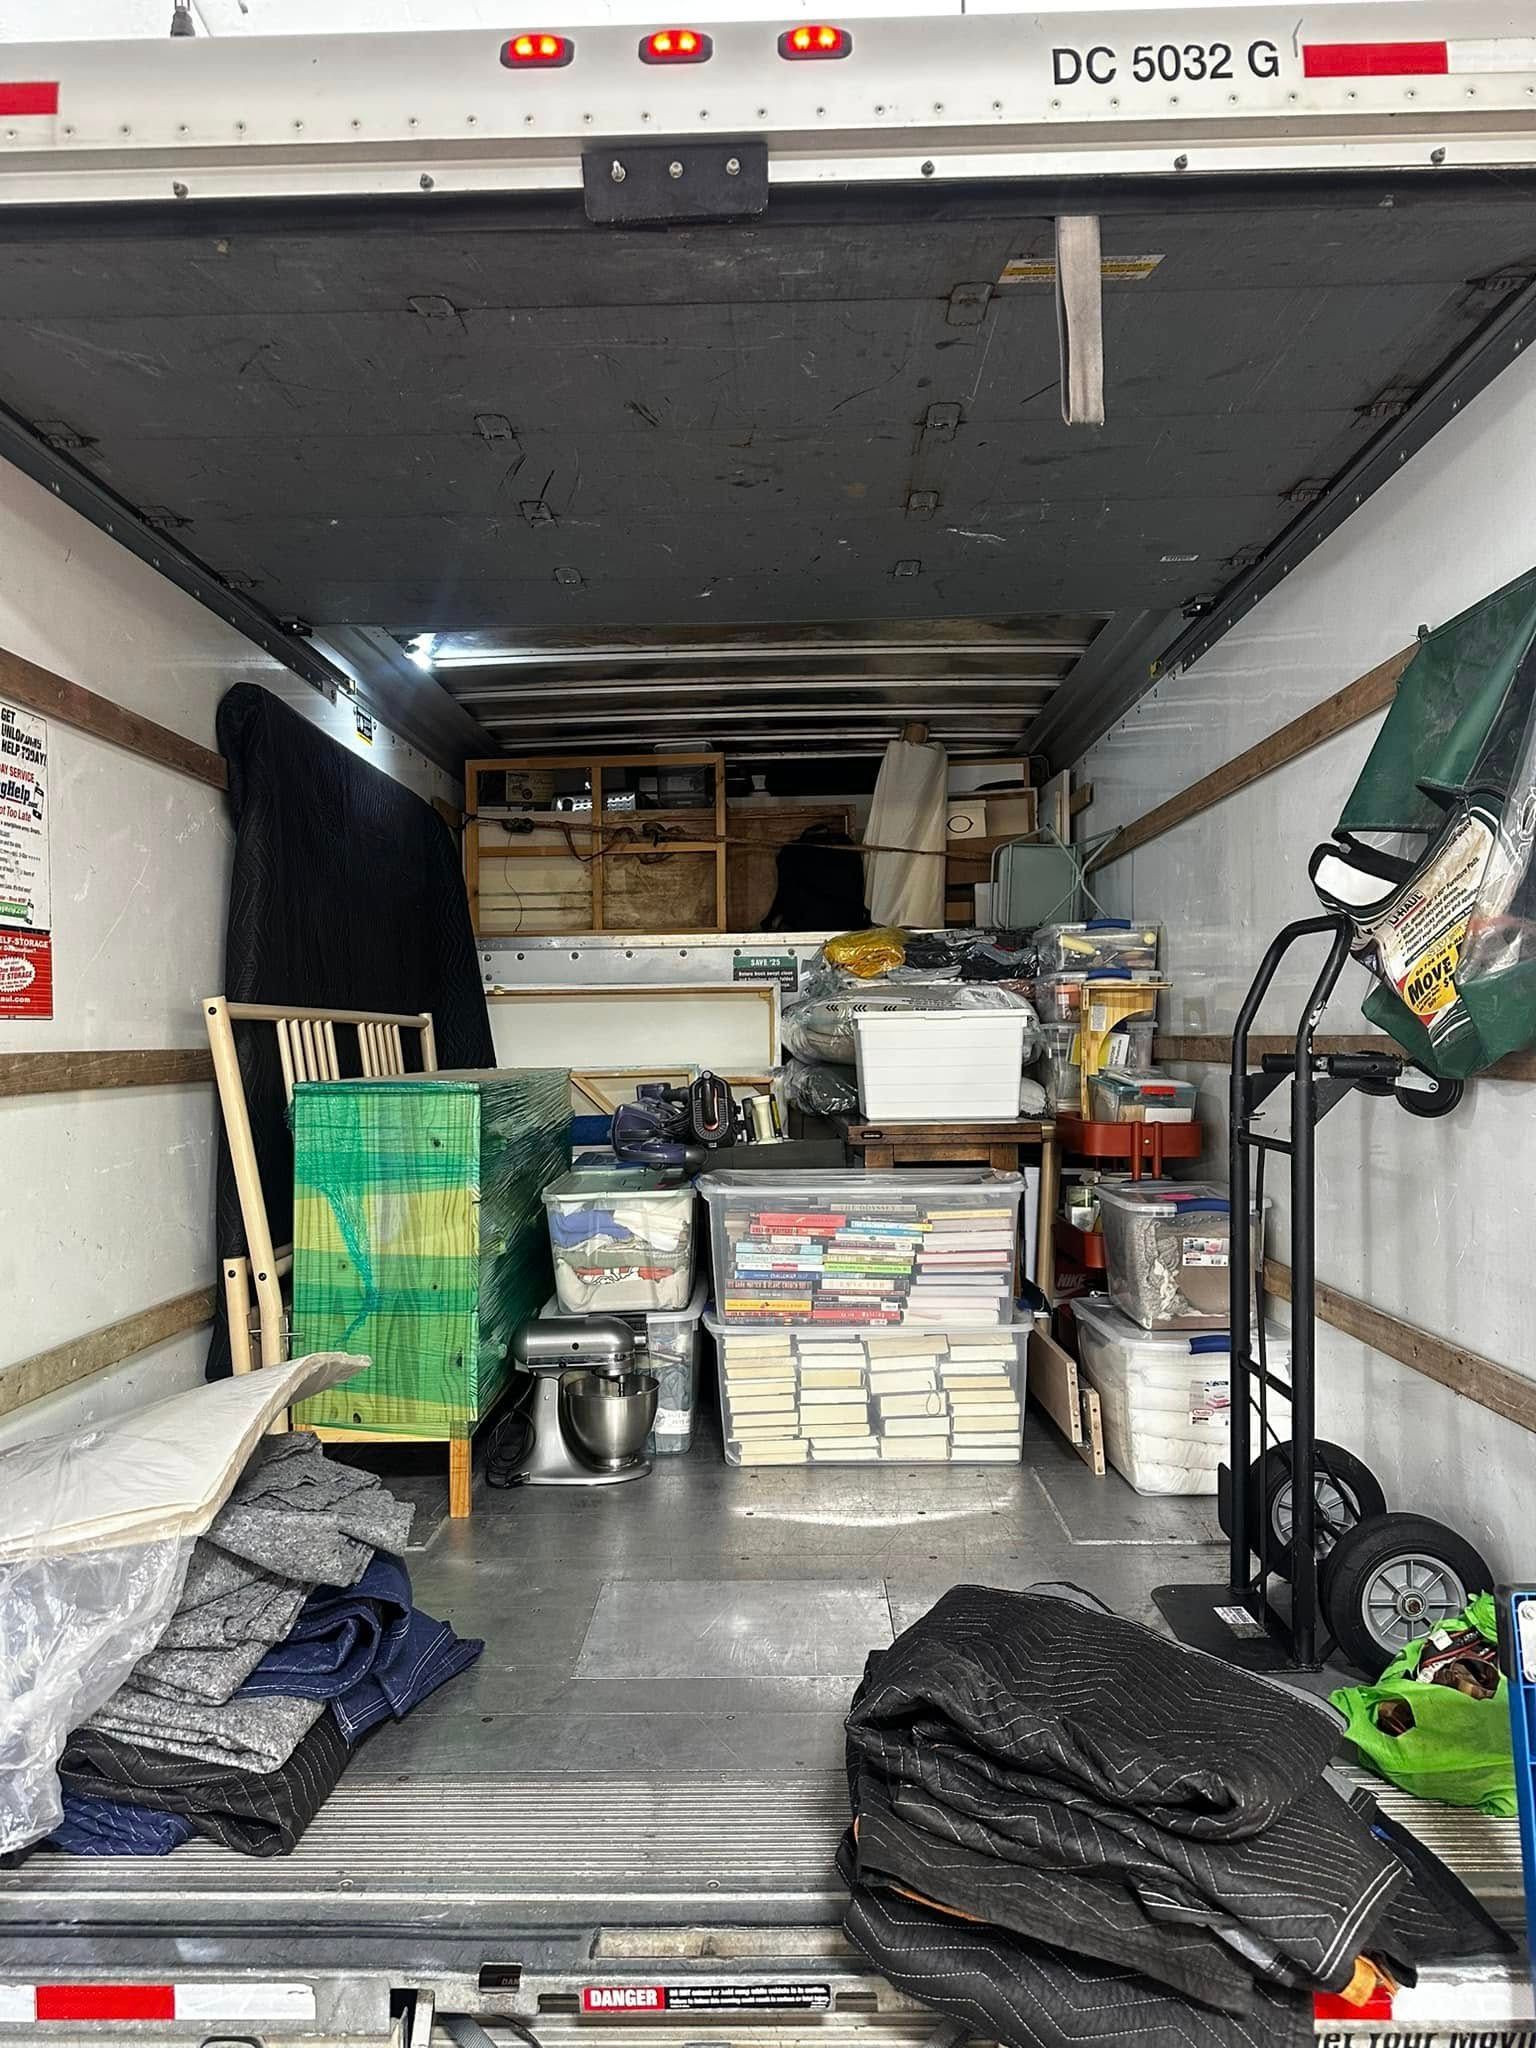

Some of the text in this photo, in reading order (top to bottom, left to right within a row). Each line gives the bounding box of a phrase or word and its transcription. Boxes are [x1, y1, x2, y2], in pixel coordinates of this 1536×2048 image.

[1052, 40, 1279, 85] DC 5032 G
[1, 707, 16, 724] GET
[1, 740, 47, 767] HELP TODAY!
[9, 766, 35, 784] SERVICE
[6, 805, 18, 818] Too
[18, 809, 32, 823] Late
[1390, 891, 1424, 924] U-HAUL
[751, 958, 768, 966] SAVE
[1408, 955, 1454, 1007] MOVE
[0, 996, 31, 1004] aul.com
[1057, 1273, 1087, 1288] NIKE
[590, 1989, 658, 2007] DANGER
